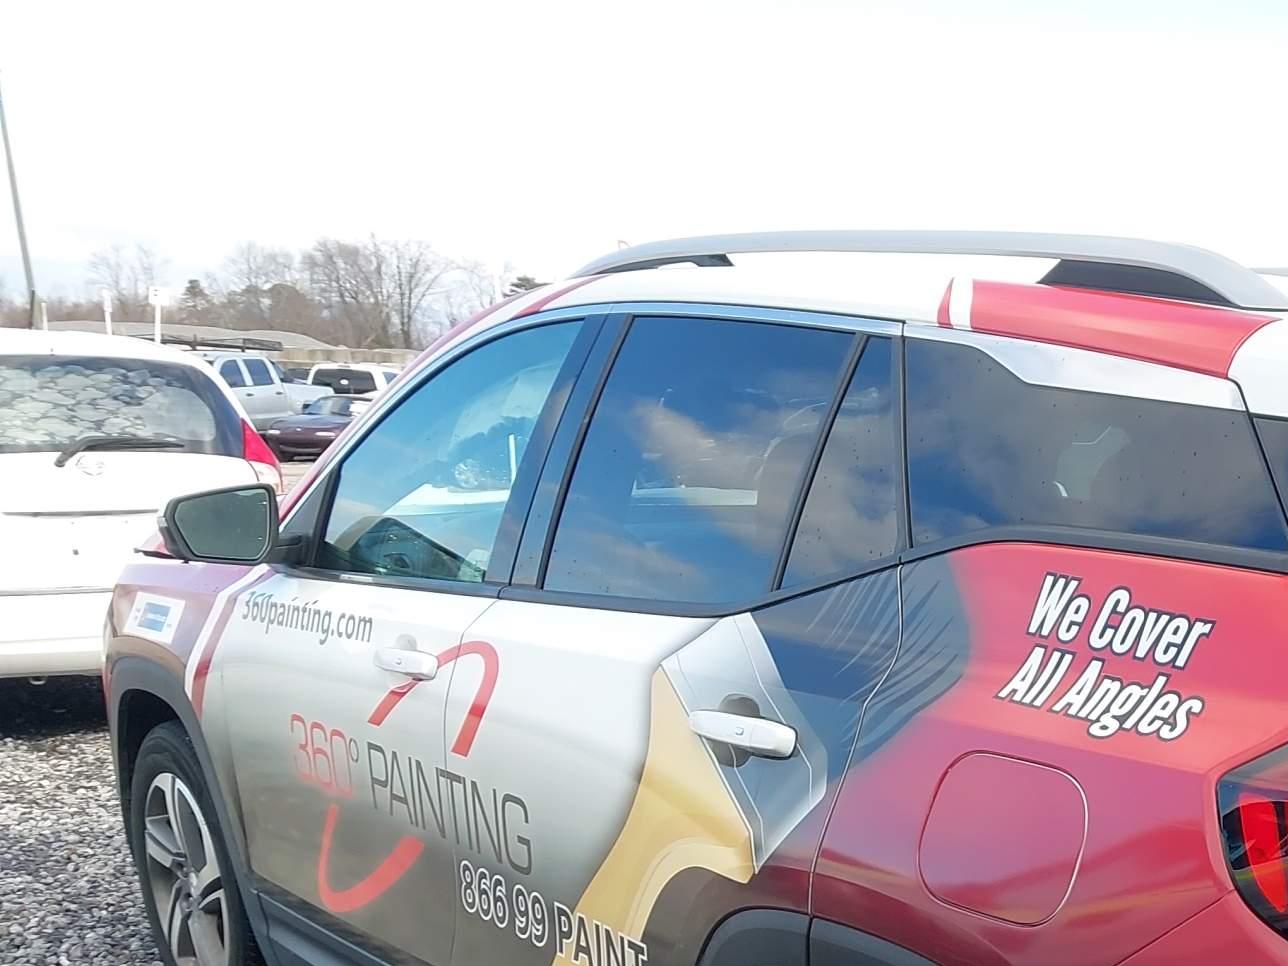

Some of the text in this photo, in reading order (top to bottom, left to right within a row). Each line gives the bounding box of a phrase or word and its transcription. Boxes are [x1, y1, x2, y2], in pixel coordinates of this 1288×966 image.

[242, 591, 373, 646] 360painting.com
[1026, 572, 1216, 671] We Cover
[993, 643, 1205, 742] All Angles
[366, 741, 533, 876] PAINTING
[460, 860, 510, 928] 866
[513, 884, 549, 947] 99
